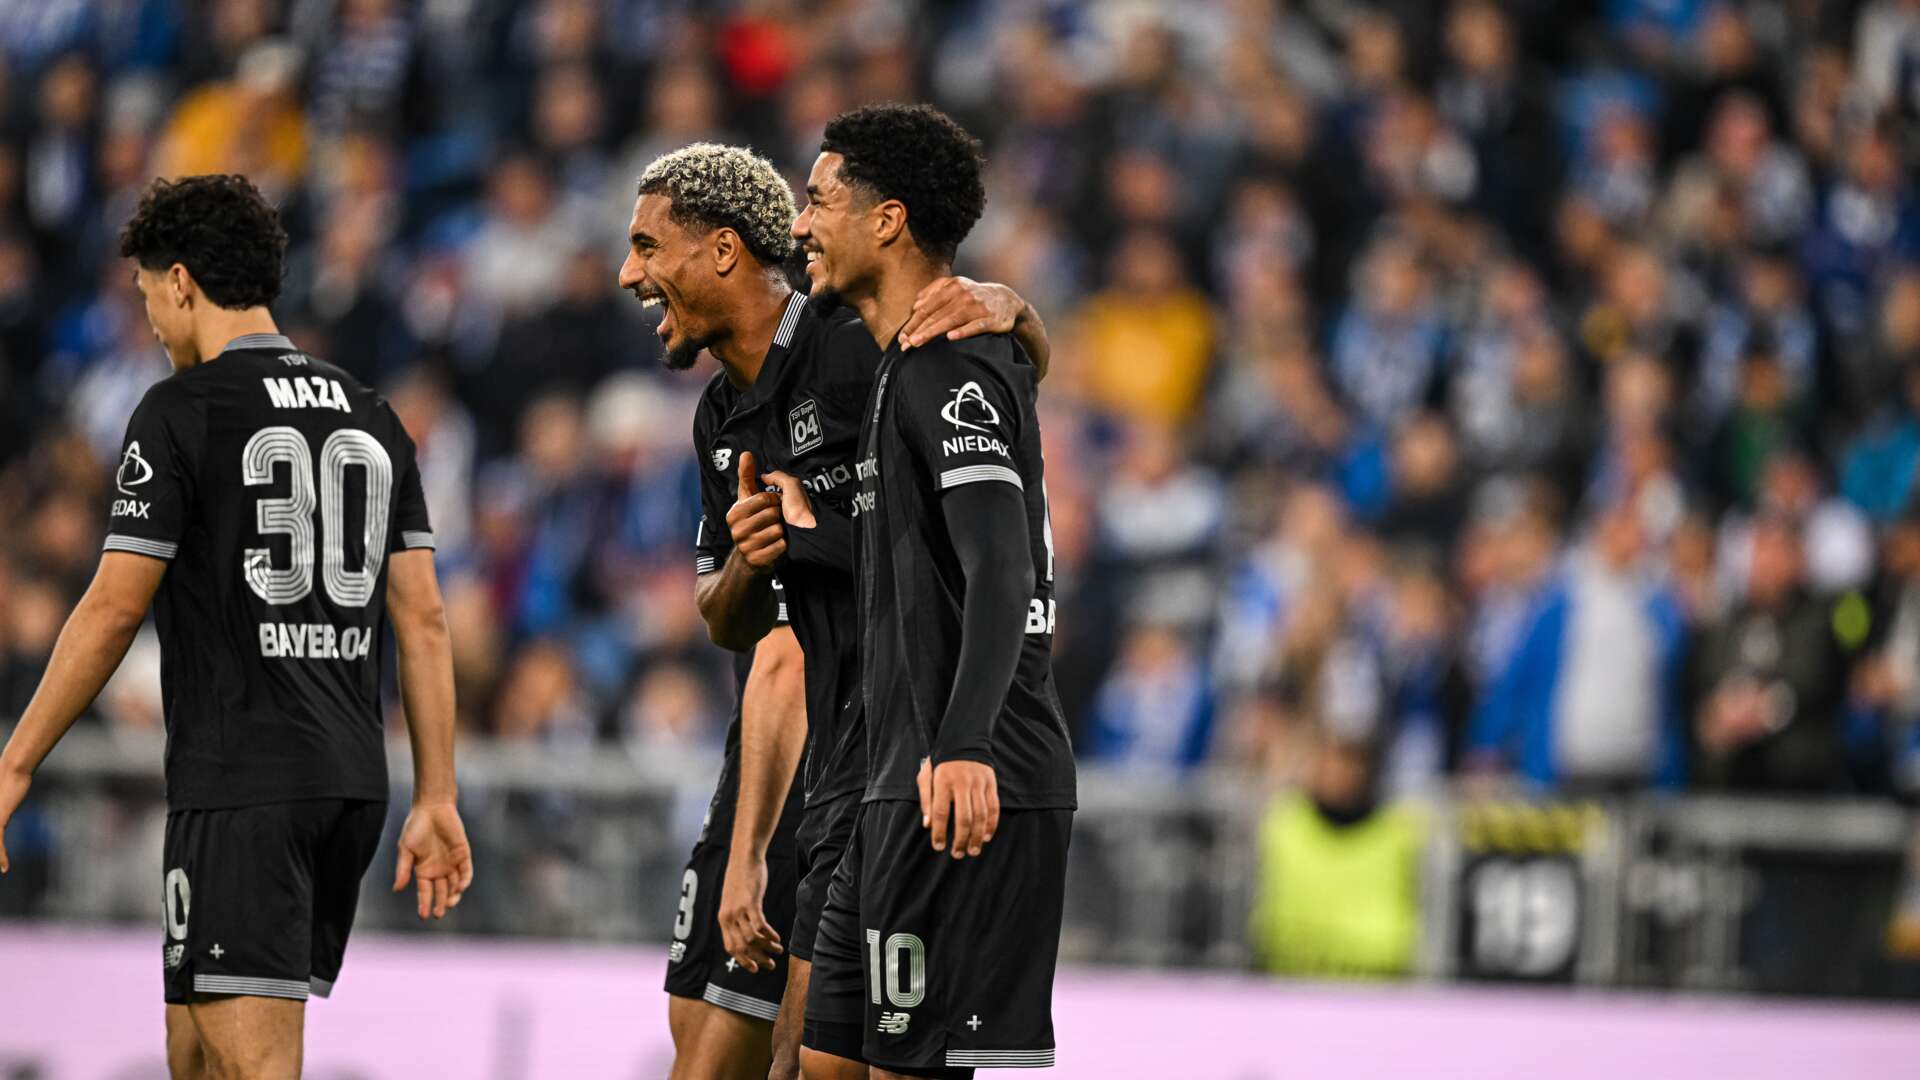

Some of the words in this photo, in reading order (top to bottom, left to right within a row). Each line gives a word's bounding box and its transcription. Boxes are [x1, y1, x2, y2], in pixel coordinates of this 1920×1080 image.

[263, 376, 352, 413] MAZA
[795, 413, 818, 443] 04
[942, 435, 1012, 460] NIEDAX
[111, 499, 151, 519] EDAX
[242, 426, 393, 607] 30
[1024, 598, 1056, 634] BA
[259, 622, 340, 659] BAYER
[340, 626, 372, 661] 04
[162, 867, 192, 941] 0
[867, 929, 926, 1007] 10
